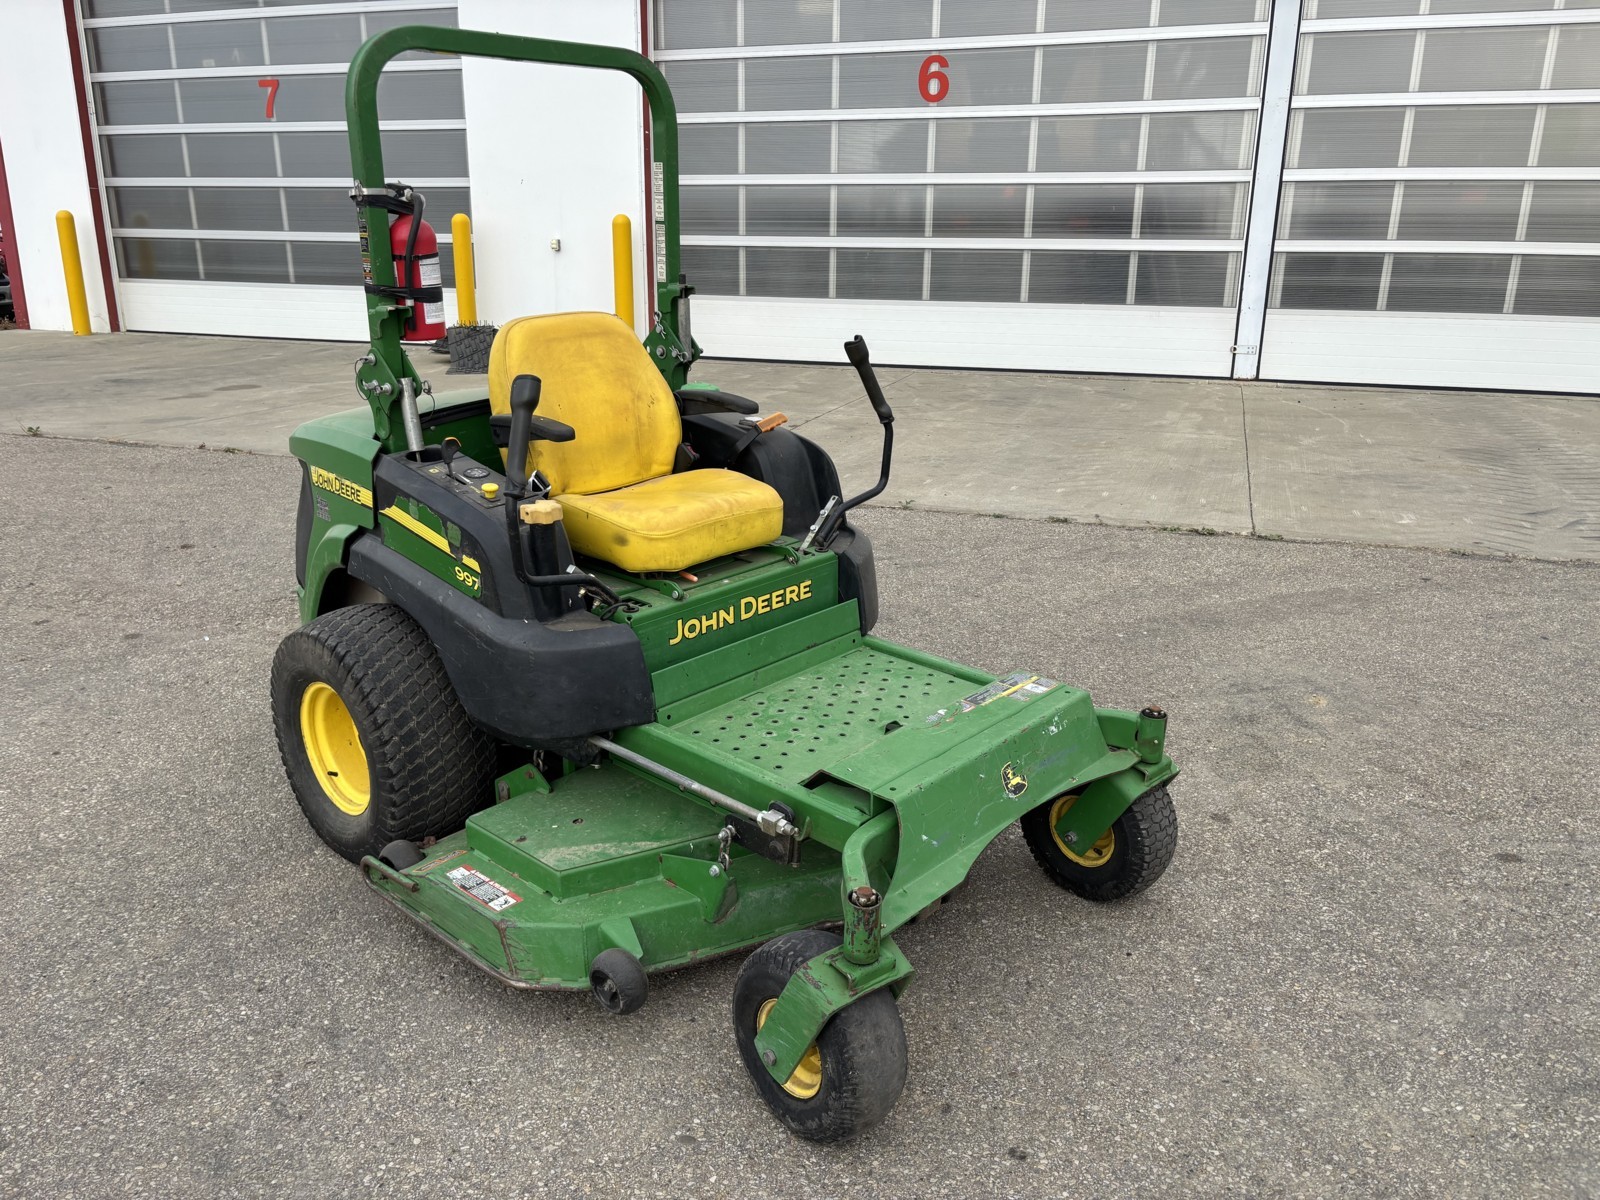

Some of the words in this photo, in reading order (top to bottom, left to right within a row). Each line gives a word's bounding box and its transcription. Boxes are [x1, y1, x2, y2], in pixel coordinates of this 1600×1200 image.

[918, 54, 949, 102] 6
[258, 79, 279, 118] 7
[313, 467, 334, 491] JOHN
[334, 477, 361, 503] DEERE
[454, 566, 479, 590] 997
[669, 605, 735, 646] JOHN
[740, 579, 812, 621] DEERE
